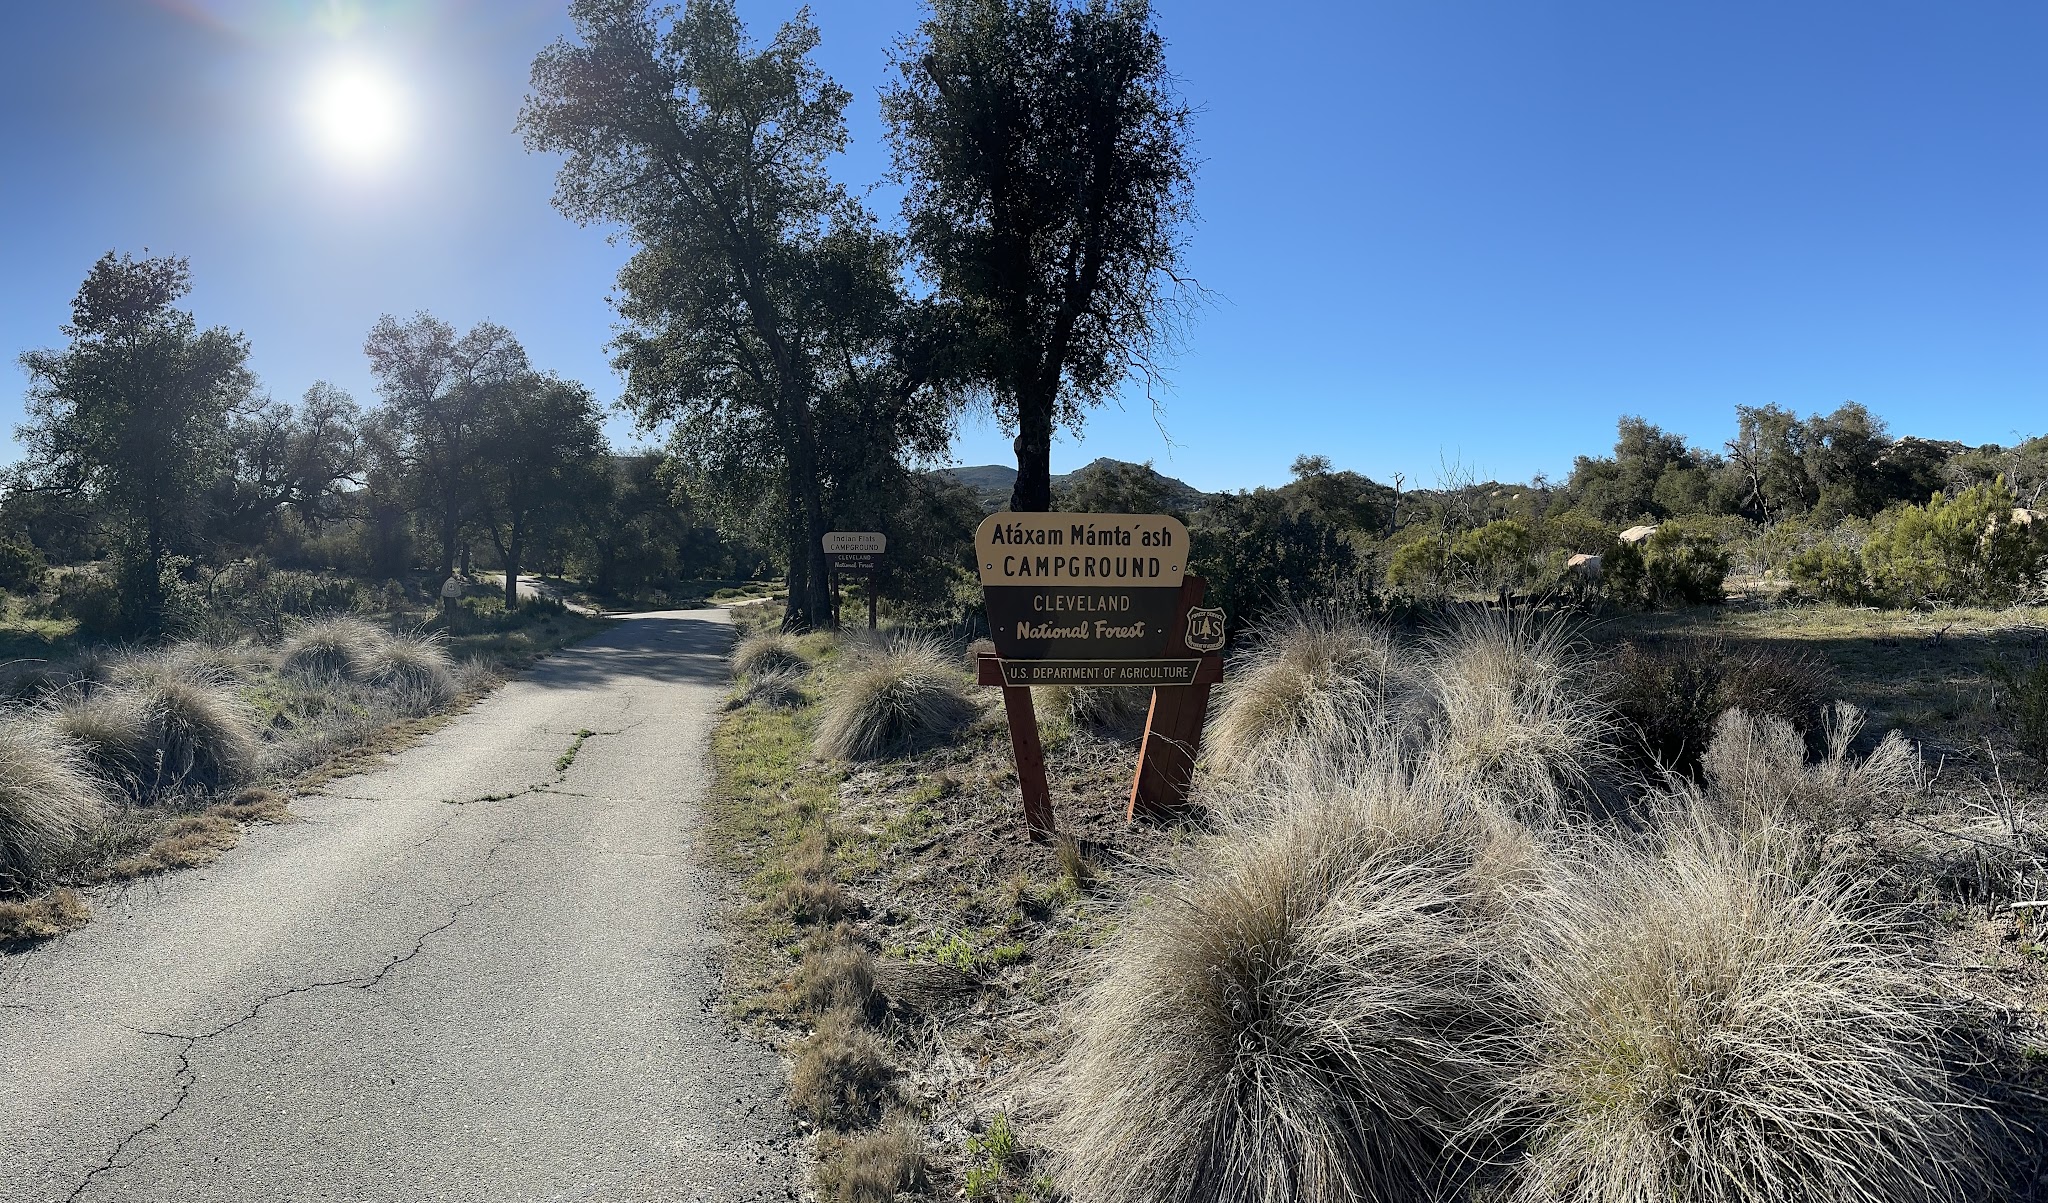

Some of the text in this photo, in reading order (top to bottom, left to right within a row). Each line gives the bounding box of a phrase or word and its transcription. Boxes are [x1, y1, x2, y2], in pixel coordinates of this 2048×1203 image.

[991, 522, 1063, 545] Atáxam
[1003, 555, 1160, 578] CAMPGROUND
[1033, 594, 1130, 612] CLEVELAND
[1016, 619, 1146, 640] National Forest
[1010, 664, 1189, 679] U.S. DEPARTMENT OF AGRICULTURE
